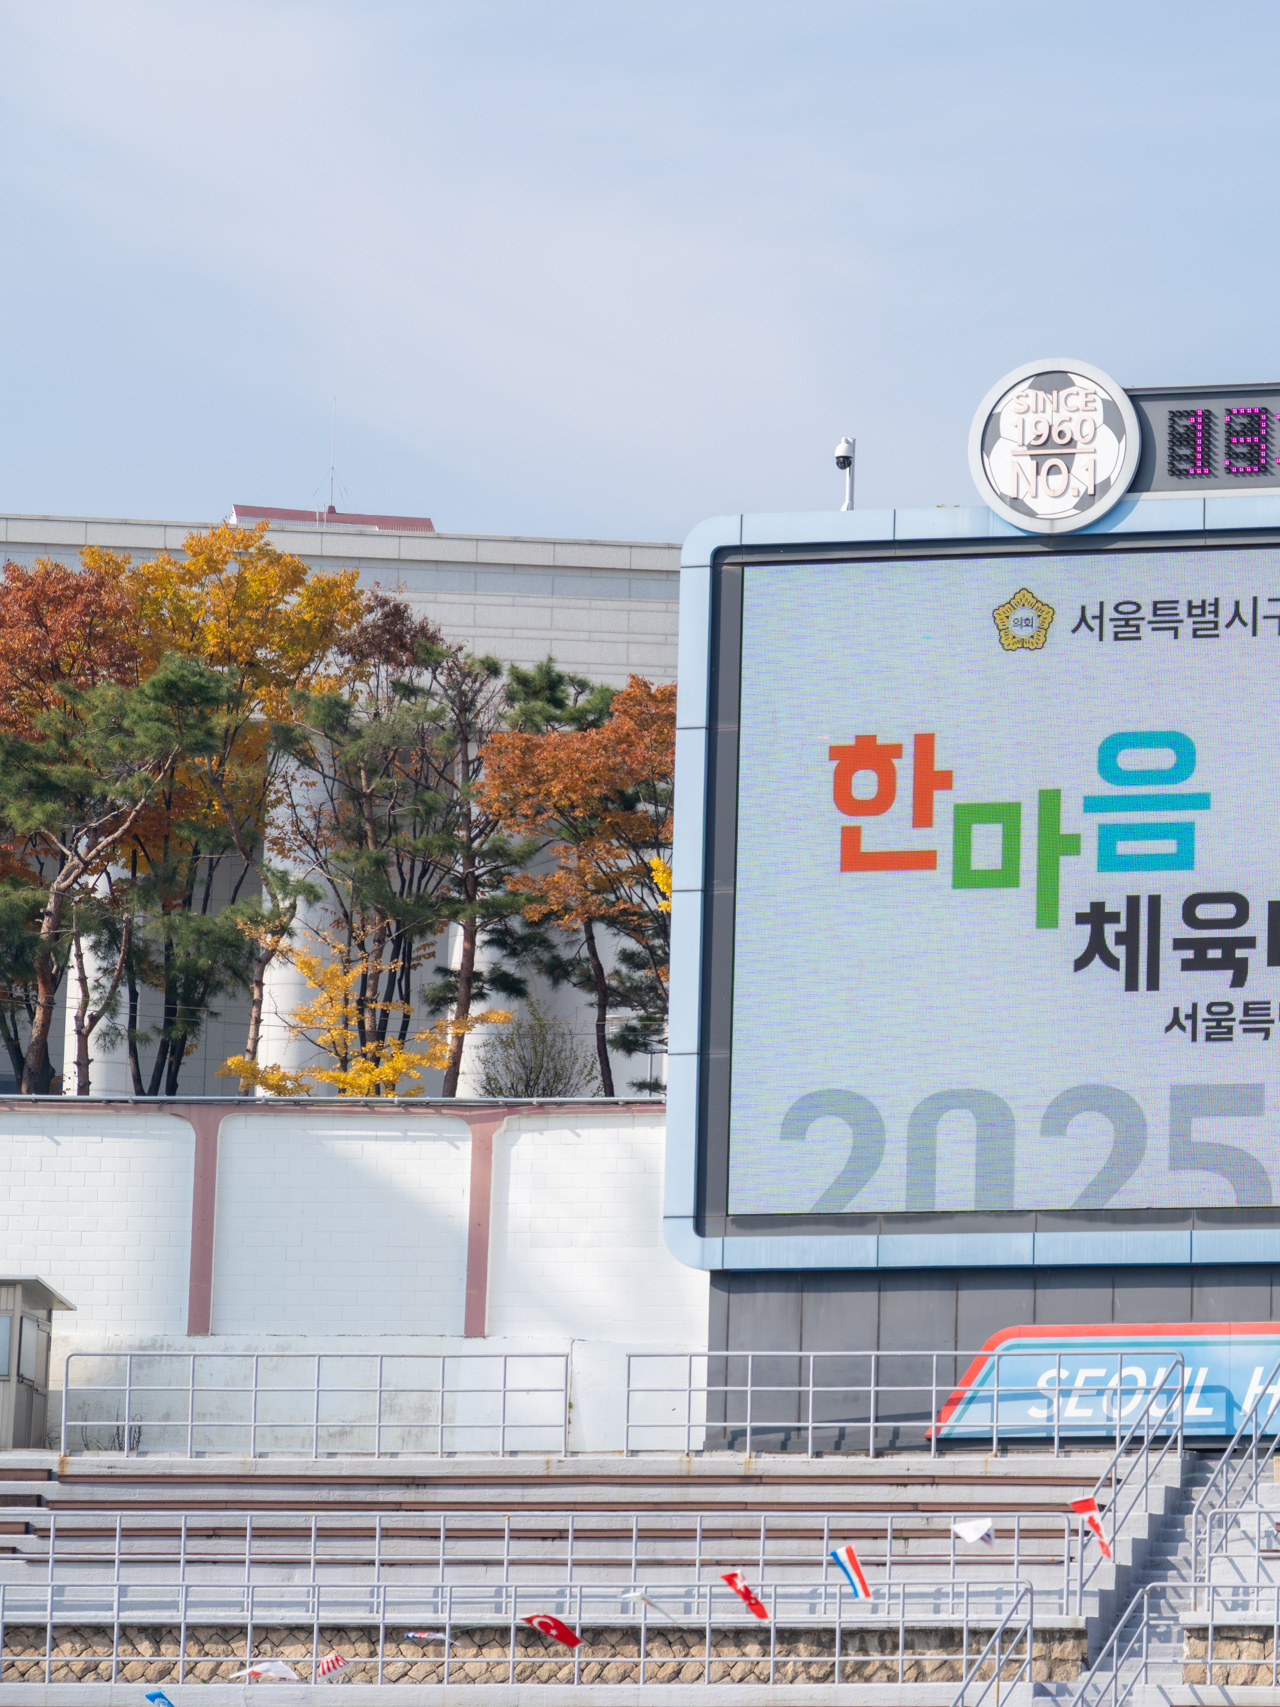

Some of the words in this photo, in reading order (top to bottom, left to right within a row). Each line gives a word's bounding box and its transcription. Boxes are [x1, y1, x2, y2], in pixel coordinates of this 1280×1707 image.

[1012, 389, 1097, 414] SINCE
[1013, 415, 1096, 446] 1960
[1010, 457, 1096, 498] NO.1
[828, 730, 1211, 929] 한마음
[779, 1083, 1274, 1213] 2025
[1027, 1366, 1215, 1418] SEOUL
